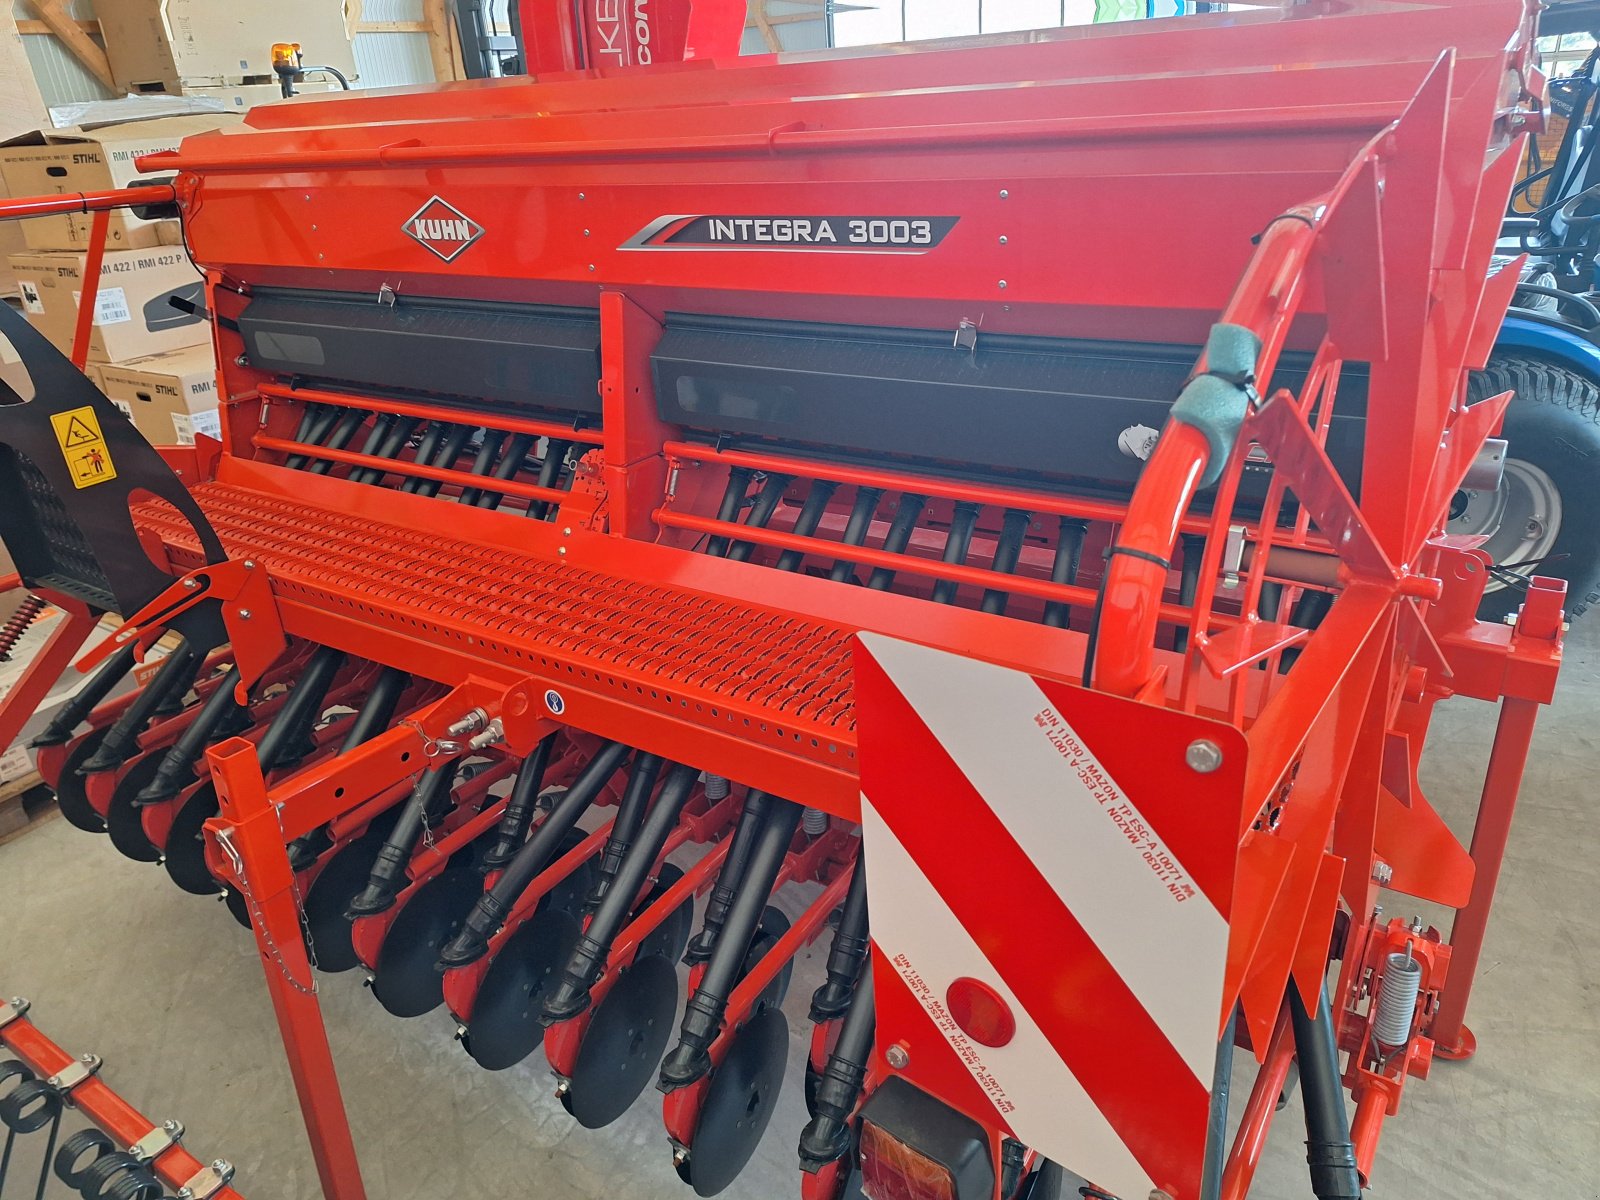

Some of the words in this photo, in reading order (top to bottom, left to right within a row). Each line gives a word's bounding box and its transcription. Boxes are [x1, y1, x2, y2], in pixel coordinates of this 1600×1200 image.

[73, 153, 101, 164] STIHL
[112, 151, 129, 162] RMI
[414, 218, 471, 241] KUHN
[707, 219, 837, 243] INTEGRA
[848, 220, 932, 244] 3003
[57, 267, 79, 278] STIHL
[113, 261, 132, 272] 422
[137, 257, 156, 269] RMI
[158, 255, 175, 266] 422
[175, 254, 182, 263] P
[155, 384, 178, 396] STIHL
[191, 381, 211, 394] RMI
[1045, 730, 1071, 759] 10071
[1069, 757, 1097, 790] ESC-A
[1041, 707, 1060, 727] DIN
[1057, 727, 1085, 758] 11030
[1086, 764, 1120, 801] MAZON
[1118, 803, 1133, 817] TP
[1129, 818, 1158, 851] ESC-A
[1156, 851, 1184, 882] 10071
[1093, 791, 1108, 805] TP
[1106, 807, 1140, 844] MAZON
[1142, 851, 1169, 882] 11030
[1167, 882, 1187, 903] DIN
[901, 969, 922, 994] 10071
[920, 994, 942, 1020] ESC-A
[897, 953, 912, 969] DIN
[910, 969, 930, 995] 11030
[932, 1000, 957, 1031] MAZON
[956, 1033, 968, 1045] TP
[965, 1045, 988, 1073] ESC-A
[985, 1073, 1006, 1098] 10071
[938, 1021, 951, 1033] TP
[949, 1034, 975, 1066] MAZON
[976, 1071, 997, 1097] 11030
[995, 1098, 1010, 1114] DIN
